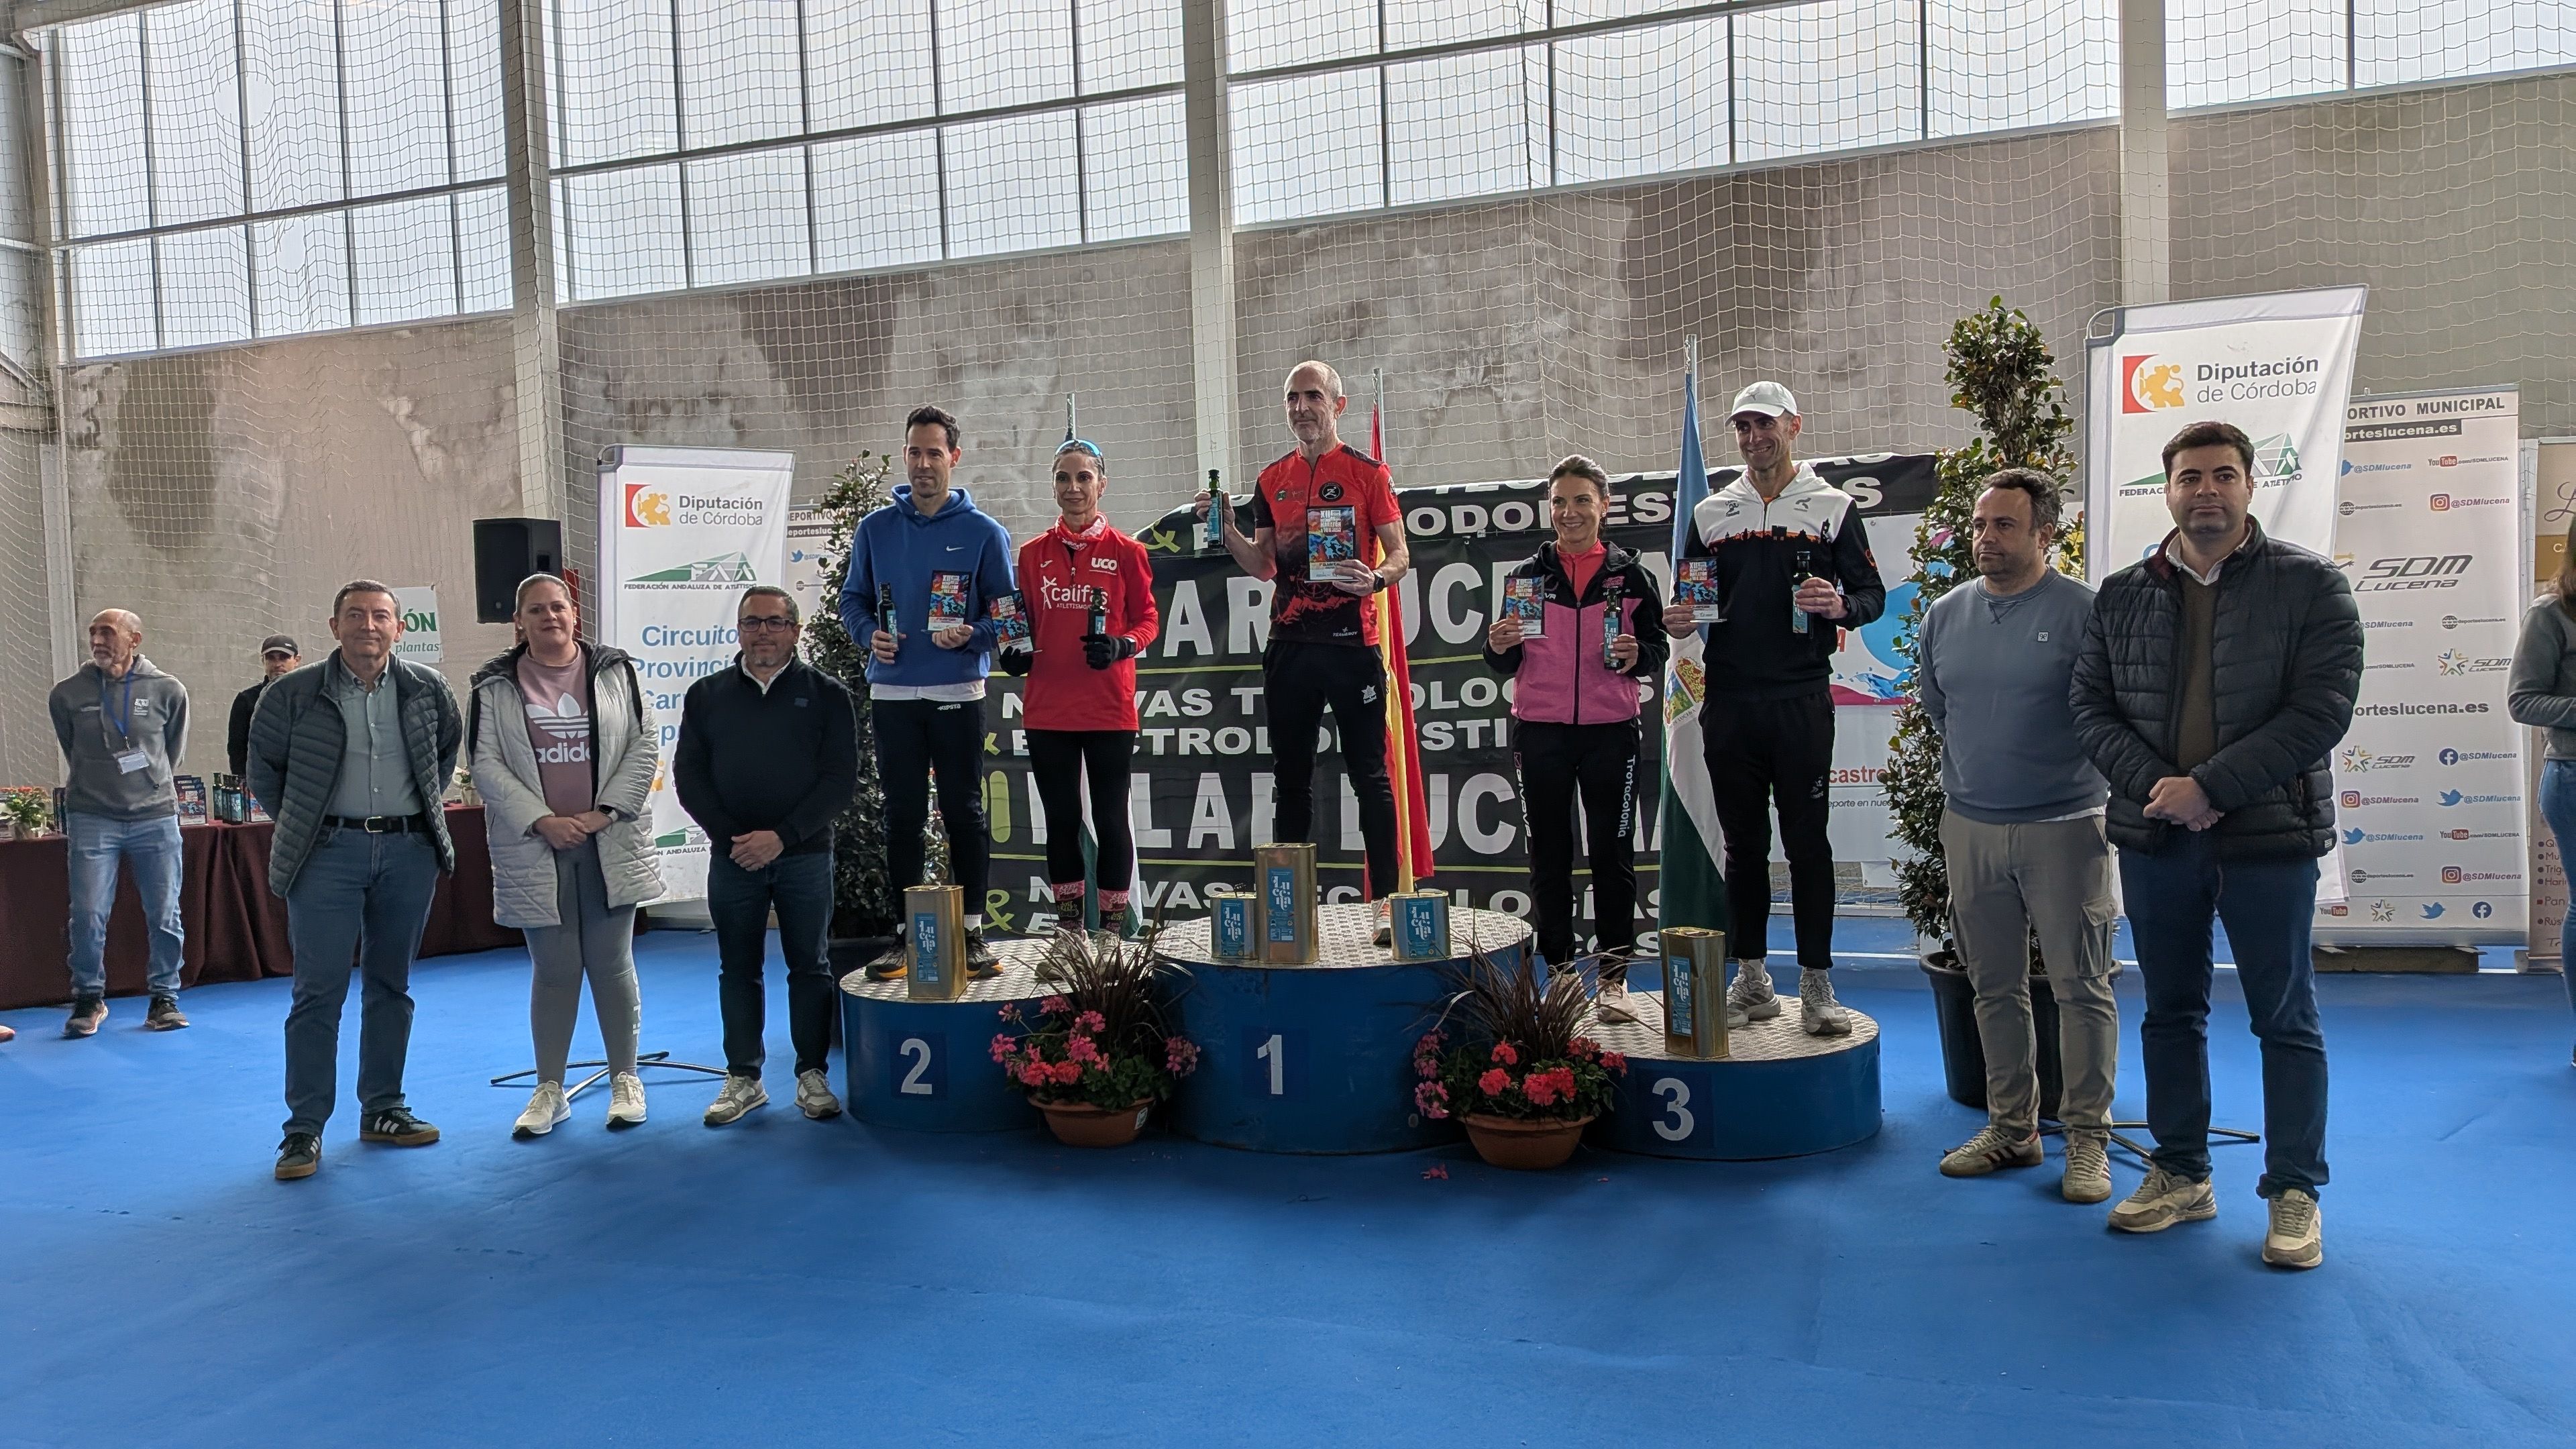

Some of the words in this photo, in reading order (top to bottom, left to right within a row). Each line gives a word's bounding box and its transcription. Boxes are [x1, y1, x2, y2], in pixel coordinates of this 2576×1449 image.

[2197, 356, 2319, 384] Diputación
[2197, 386, 2224, 403] de
[2231, 378, 2317, 400] Córdoba
[2416, 396, 2505, 415] MUNICIPAL
[2354, 463, 2412, 474] @SDMlucena
[2119, 486, 2167, 497] FEDERACI
[679, 495, 763, 511] Diputación
[2451, 497, 2510, 508] @SDMlucena
[679, 512, 698, 525] de
[702, 511, 763, 526] Córdoba
[788, 511, 833, 521] EPORTIVO
[1091, 557, 1118, 571] UCO
[2364, 555, 2473, 579] SDM
[624, 582, 669, 590] FEDERACIÓN
[2354, 578, 2459, 592] Lucena
[642, 625, 738, 647] Circuito
[395, 641, 441, 655] plantas
[2473, 658, 2512, 667] SDM
[2376, 755, 2415, 764] SDM
[2459, 751, 2517, 761] @SDMlucena
[2361, 796, 2419, 806] @SDMlucena
[2463, 794, 2521, 804] @SDMlucena
[2365, 833, 2424, 843] @SDMlucena
[666, 847, 706, 855] ANDALUZA
[2463, 871, 2521, 881] @SDMlucena
[900, 1038, 932, 1095] 2
[1257, 1034, 1283, 1095] 1
[1652, 1077, 1695, 1141] 3
